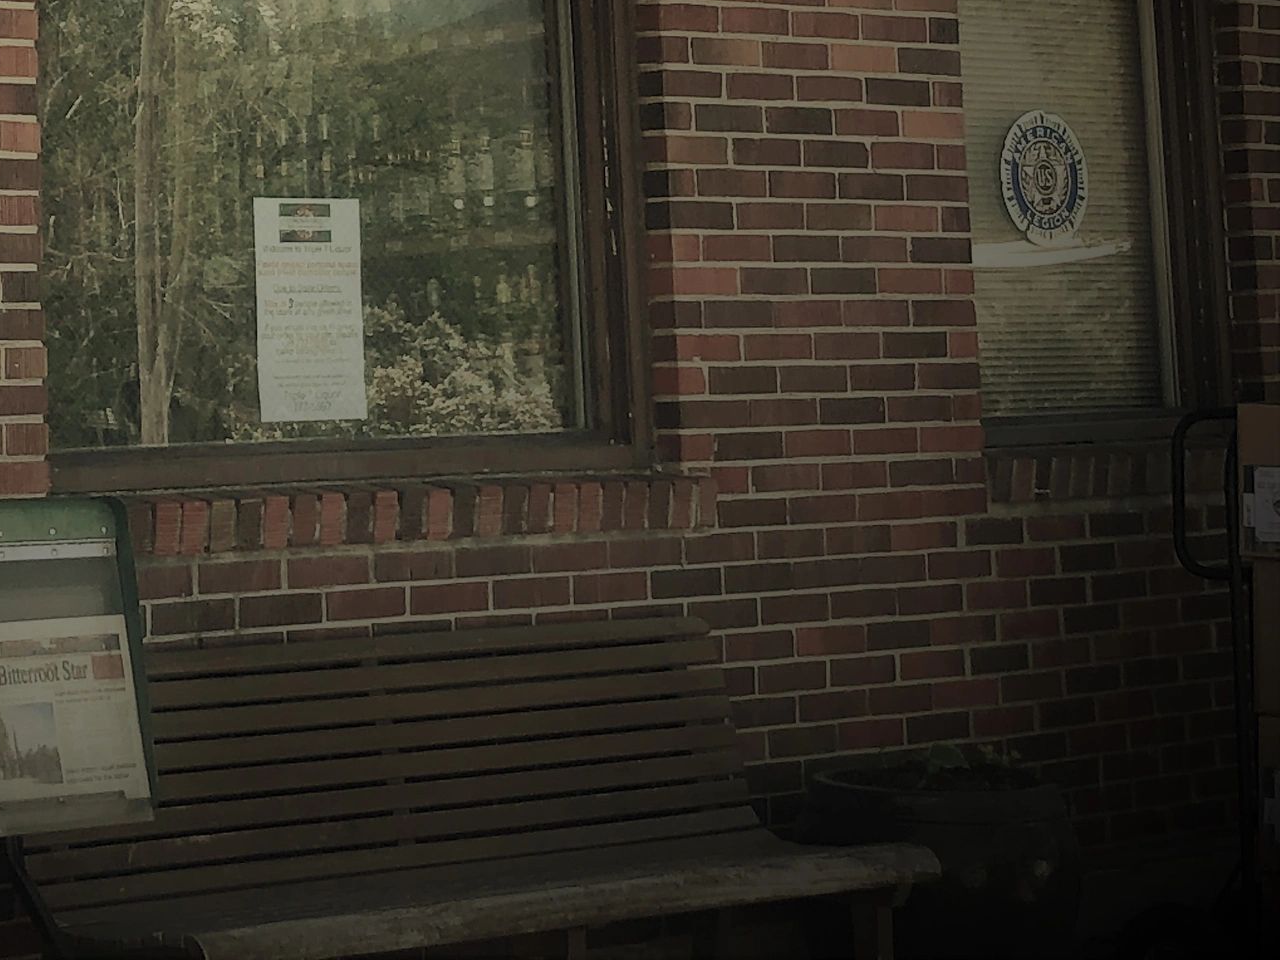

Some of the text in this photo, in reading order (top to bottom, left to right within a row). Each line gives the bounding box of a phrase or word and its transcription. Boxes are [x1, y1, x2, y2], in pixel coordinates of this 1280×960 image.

[1012, 126, 1074, 165] AMERICAN
[1026, 208, 1071, 230] LEGION
[0, 660, 89, 687] Bitterroot Star
